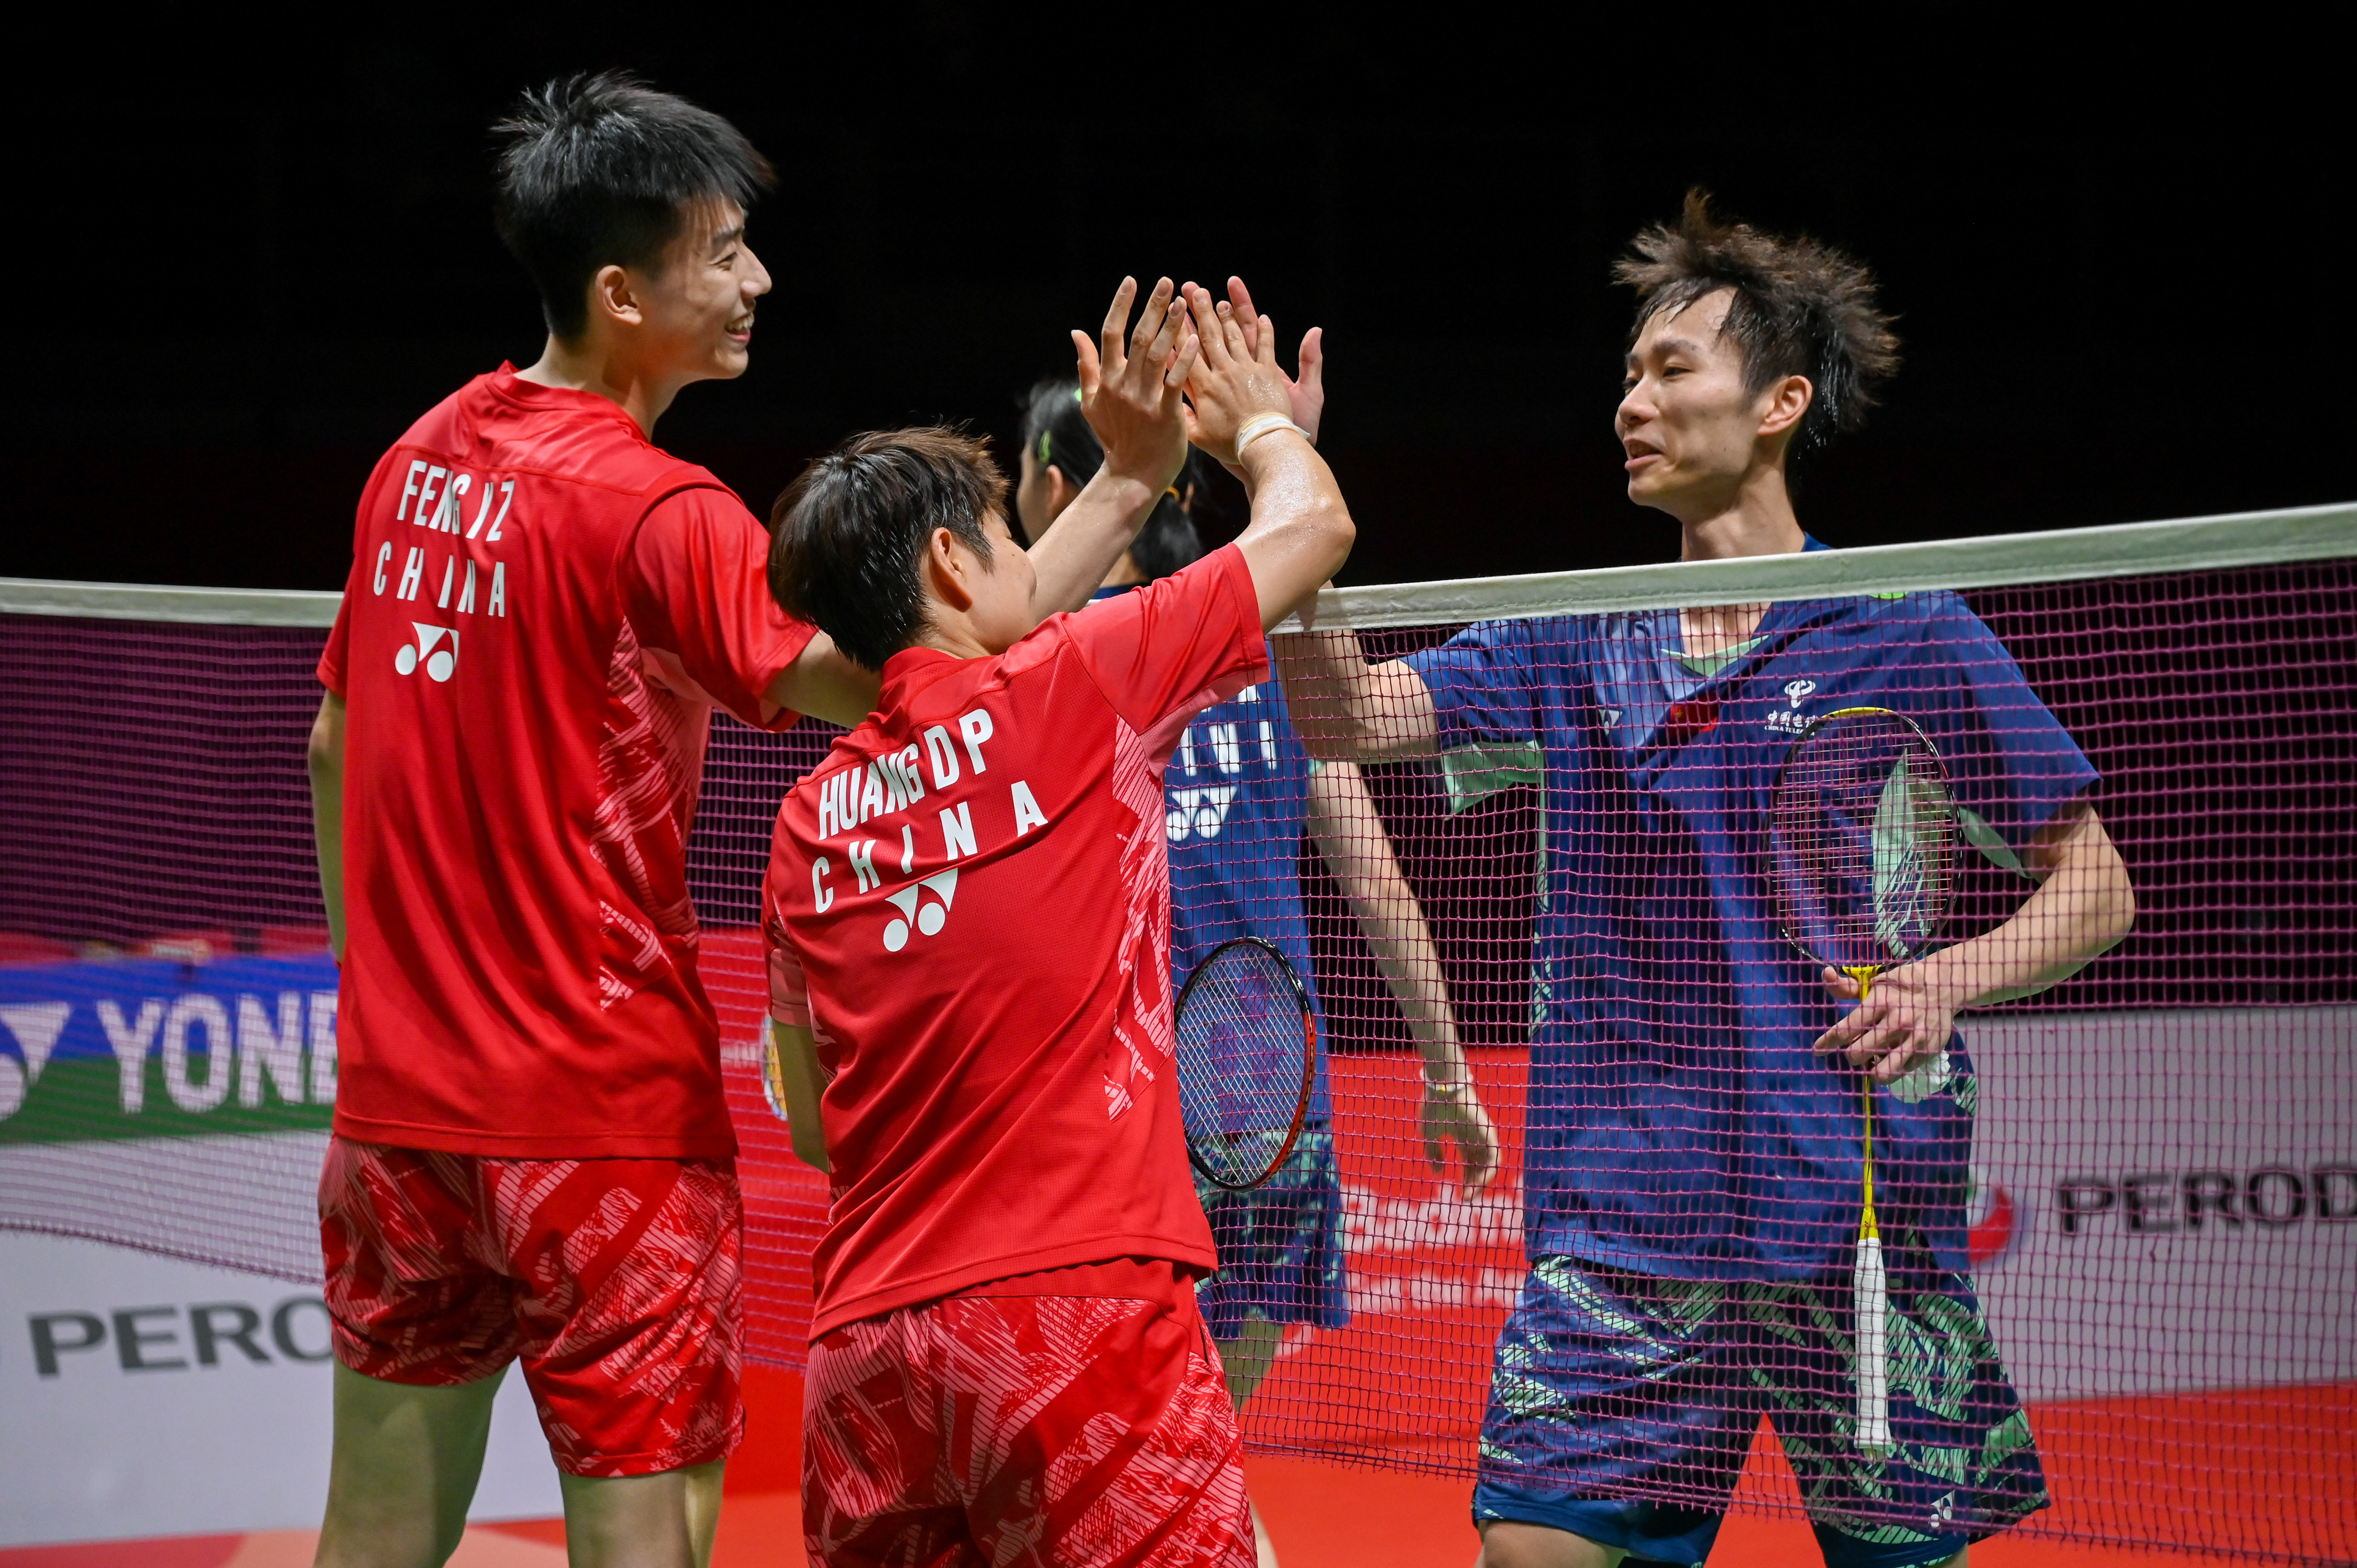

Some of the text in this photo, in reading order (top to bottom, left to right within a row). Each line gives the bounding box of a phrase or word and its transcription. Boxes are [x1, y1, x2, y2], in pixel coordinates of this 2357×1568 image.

[373, 541, 505, 617] CHINA
[819, 708, 994, 841] HUANG DP
[812, 780, 1048, 914] CHINA
[27, 1294, 334, 1380] PERO
